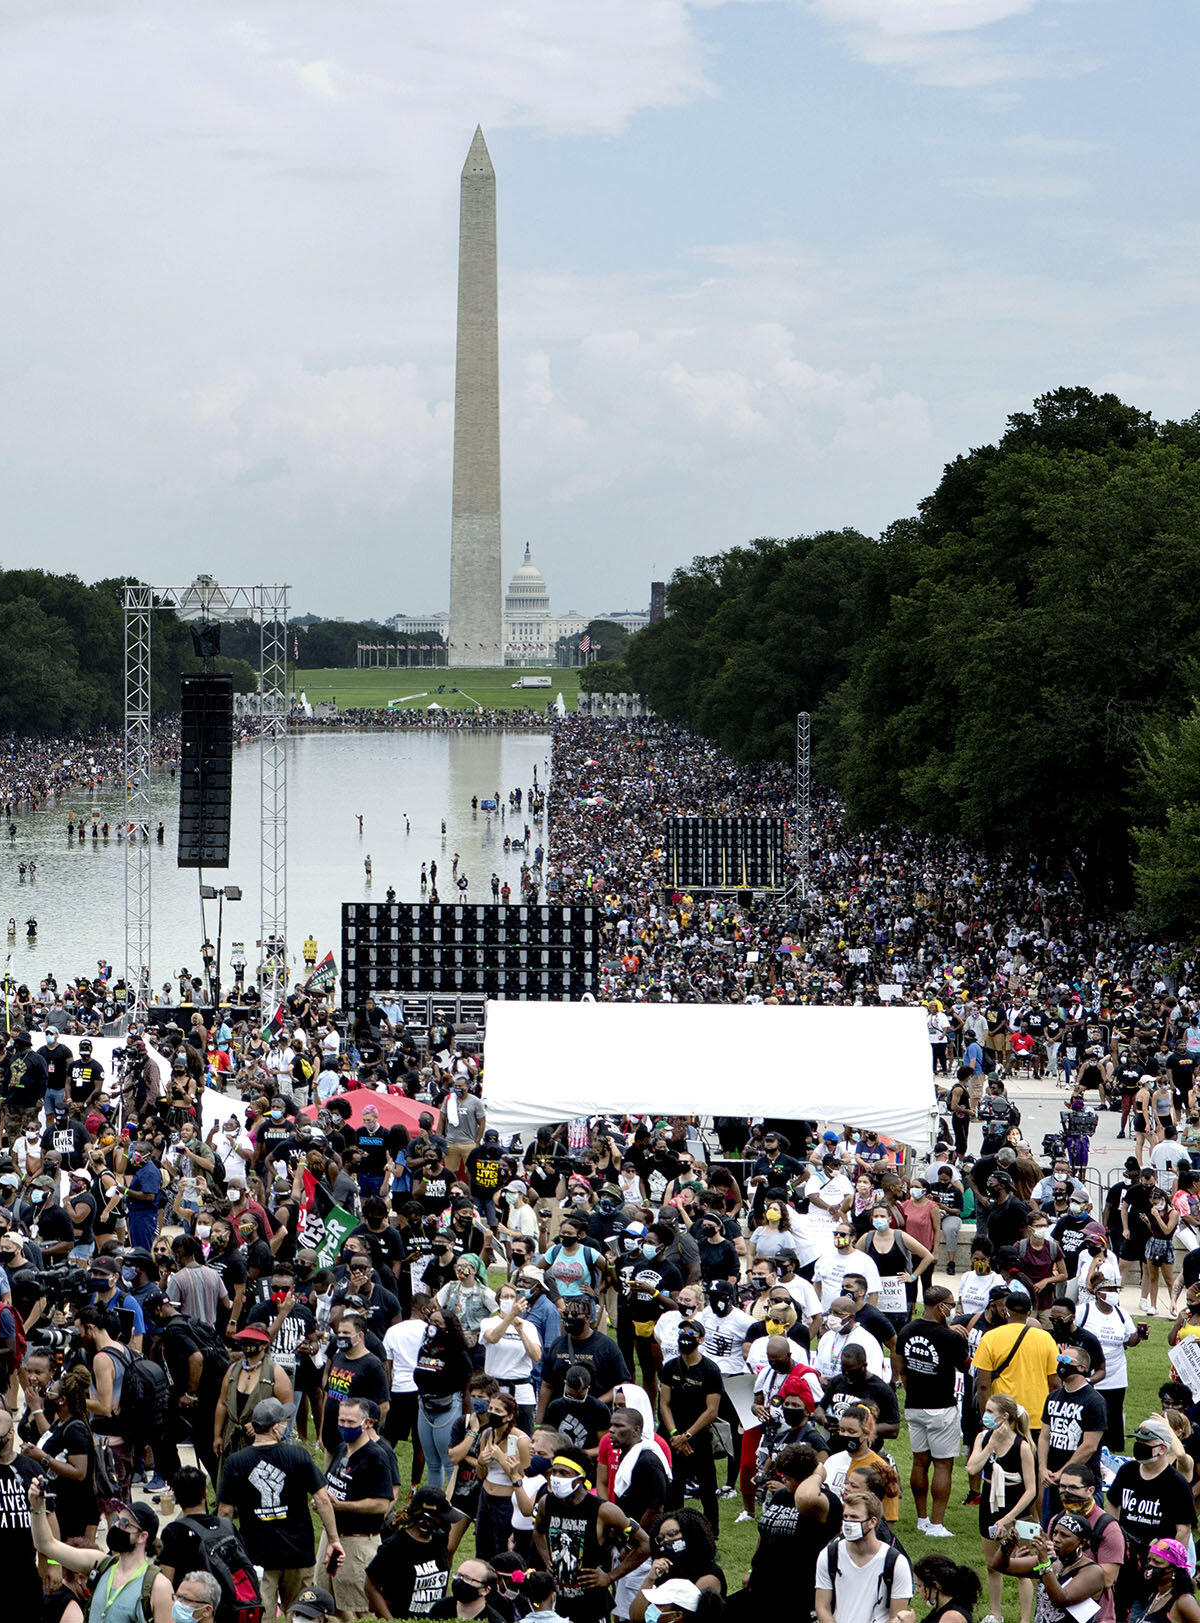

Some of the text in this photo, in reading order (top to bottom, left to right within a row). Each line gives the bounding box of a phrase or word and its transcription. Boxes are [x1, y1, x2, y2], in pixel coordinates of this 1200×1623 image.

[54, 1138, 73, 1147] LIVES
[476, 1162, 499, 1170] BLACK
[476, 1169, 499, 1178] LIVES
[912, 1346, 929, 1357] 2020
[329, 1366, 355, 1383] BLACK
[328, 1389, 349, 1402] ATTER
[833, 1393, 844, 1402] GET
[1048, 1400, 1084, 1420] BLACK
[1122, 1488, 1162, 1517] We out.
[414, 1559, 440, 1576] BLACK
[416, 1575, 438, 1590] LIVES
[412, 1588, 443, 1602] MATTER
